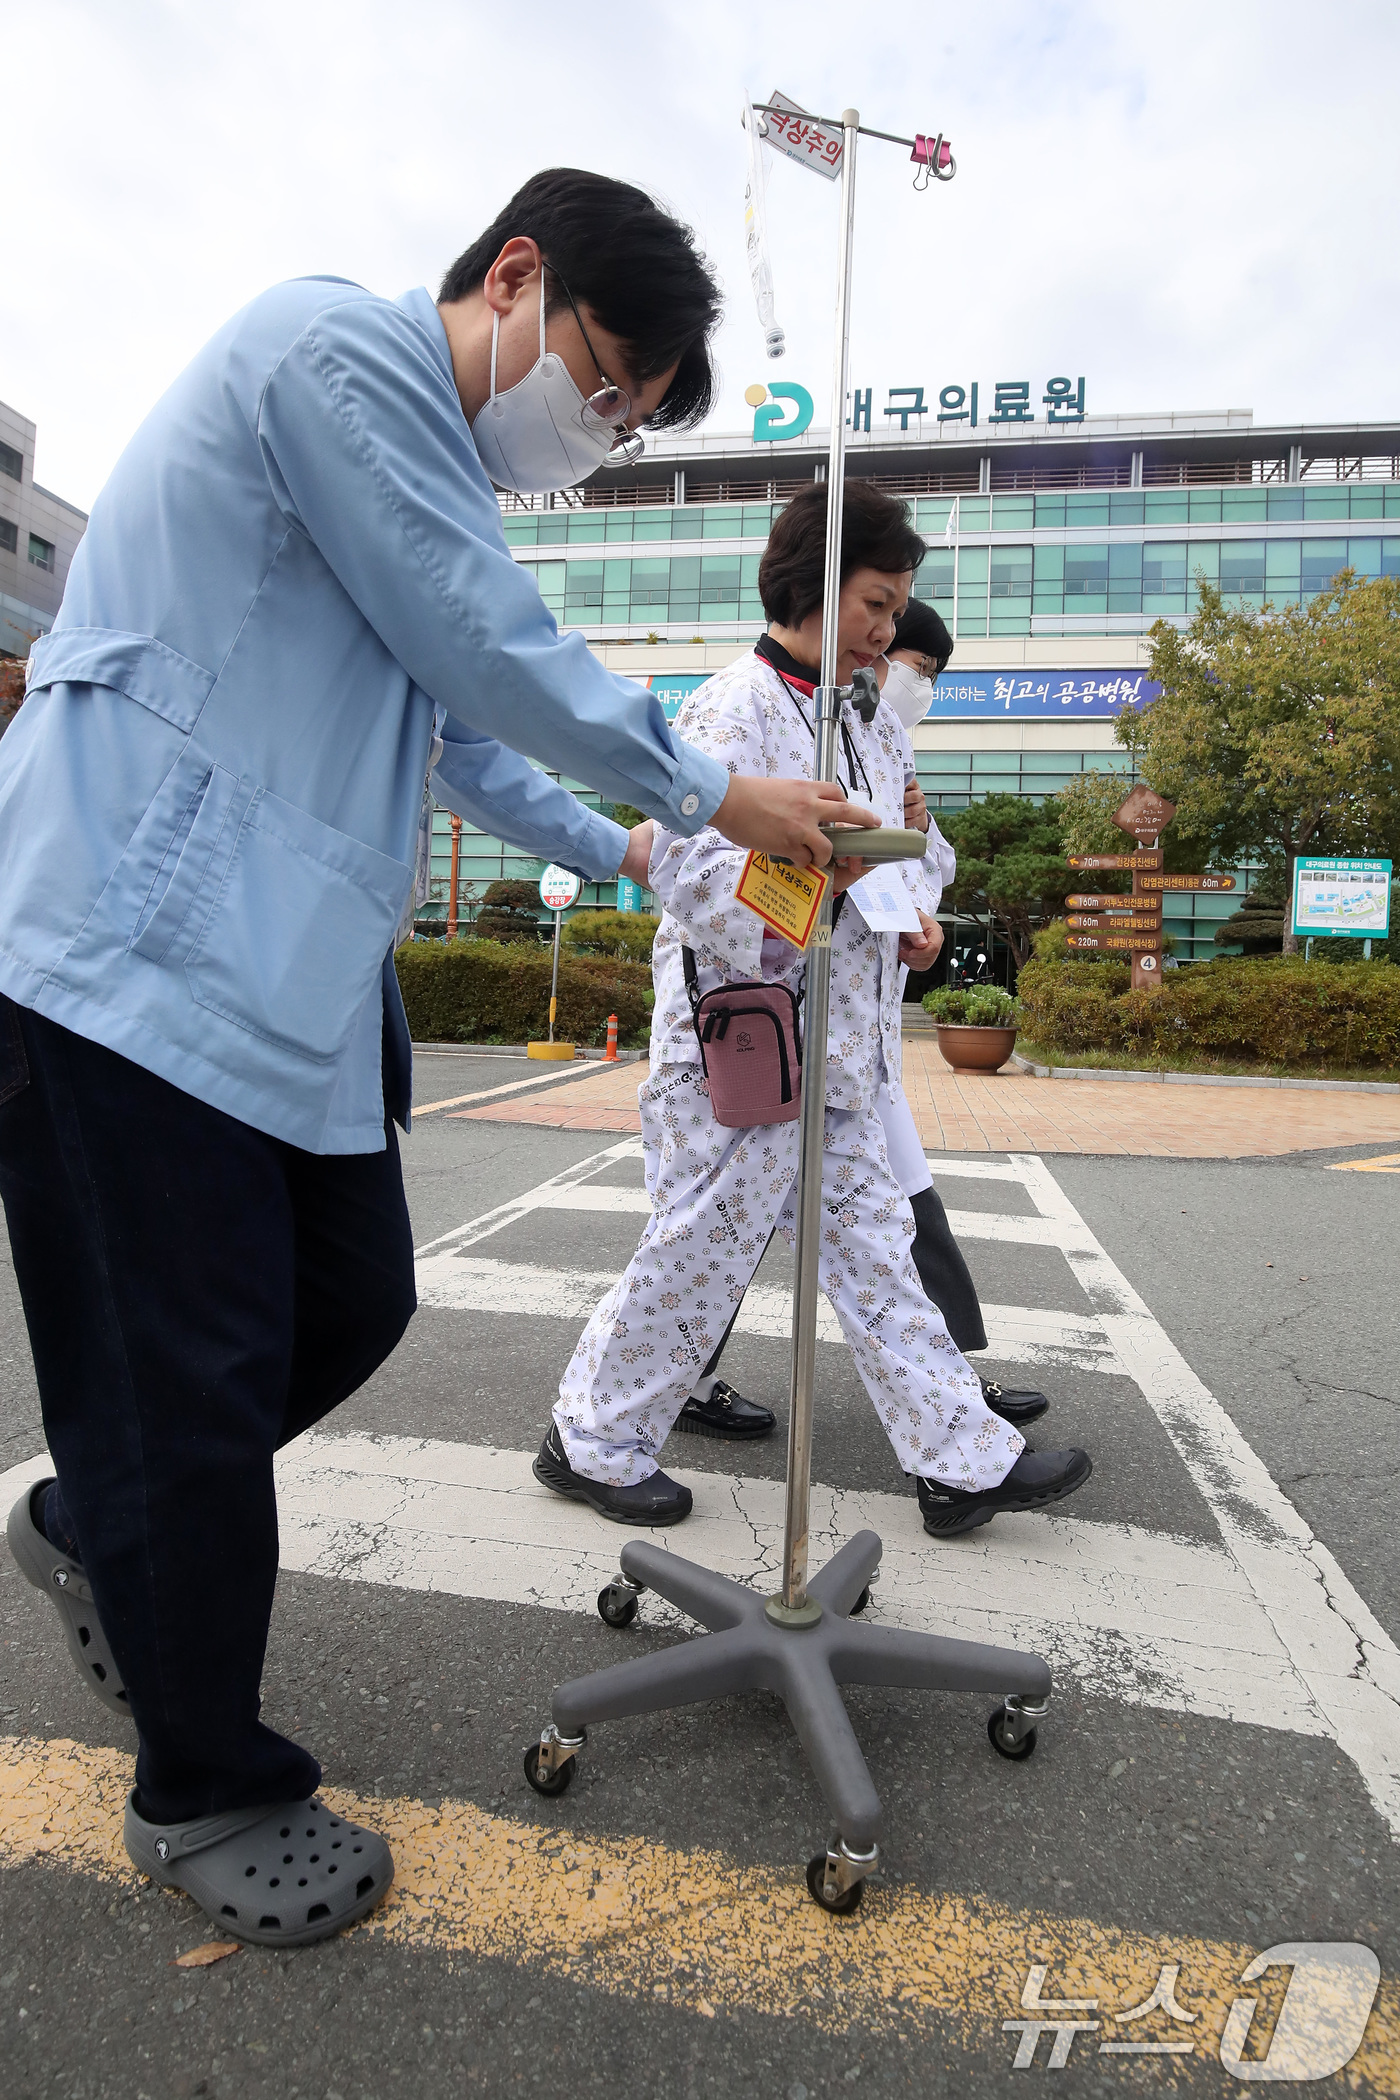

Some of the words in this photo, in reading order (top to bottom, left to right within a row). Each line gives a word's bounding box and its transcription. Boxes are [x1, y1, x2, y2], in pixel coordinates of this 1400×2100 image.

[770, 105, 843, 166] 낙상주의
[993, 677, 1050, 709] 최고의
[1052, 677, 1143, 704] 공공병원
[1083, 857, 1100, 867] 70m
[1116, 857, 1158, 868] 건강증진센터
[1305, 860, 1336, 869] 대구의료원
[1350, 861, 1363, 870] 위치
[1363, 862, 1383, 870] 안내도
[1202, 878, 1219, 888] 60m
[549, 896, 566, 905] 승강장
[1078, 897, 1099, 907] 160m
[1078, 917, 1099, 927] 160m
[1078, 937, 1099, 947] 220m
[1143, 957, 1153, 969] 4
[720, 1210, 740, 1244] 대구의료원
